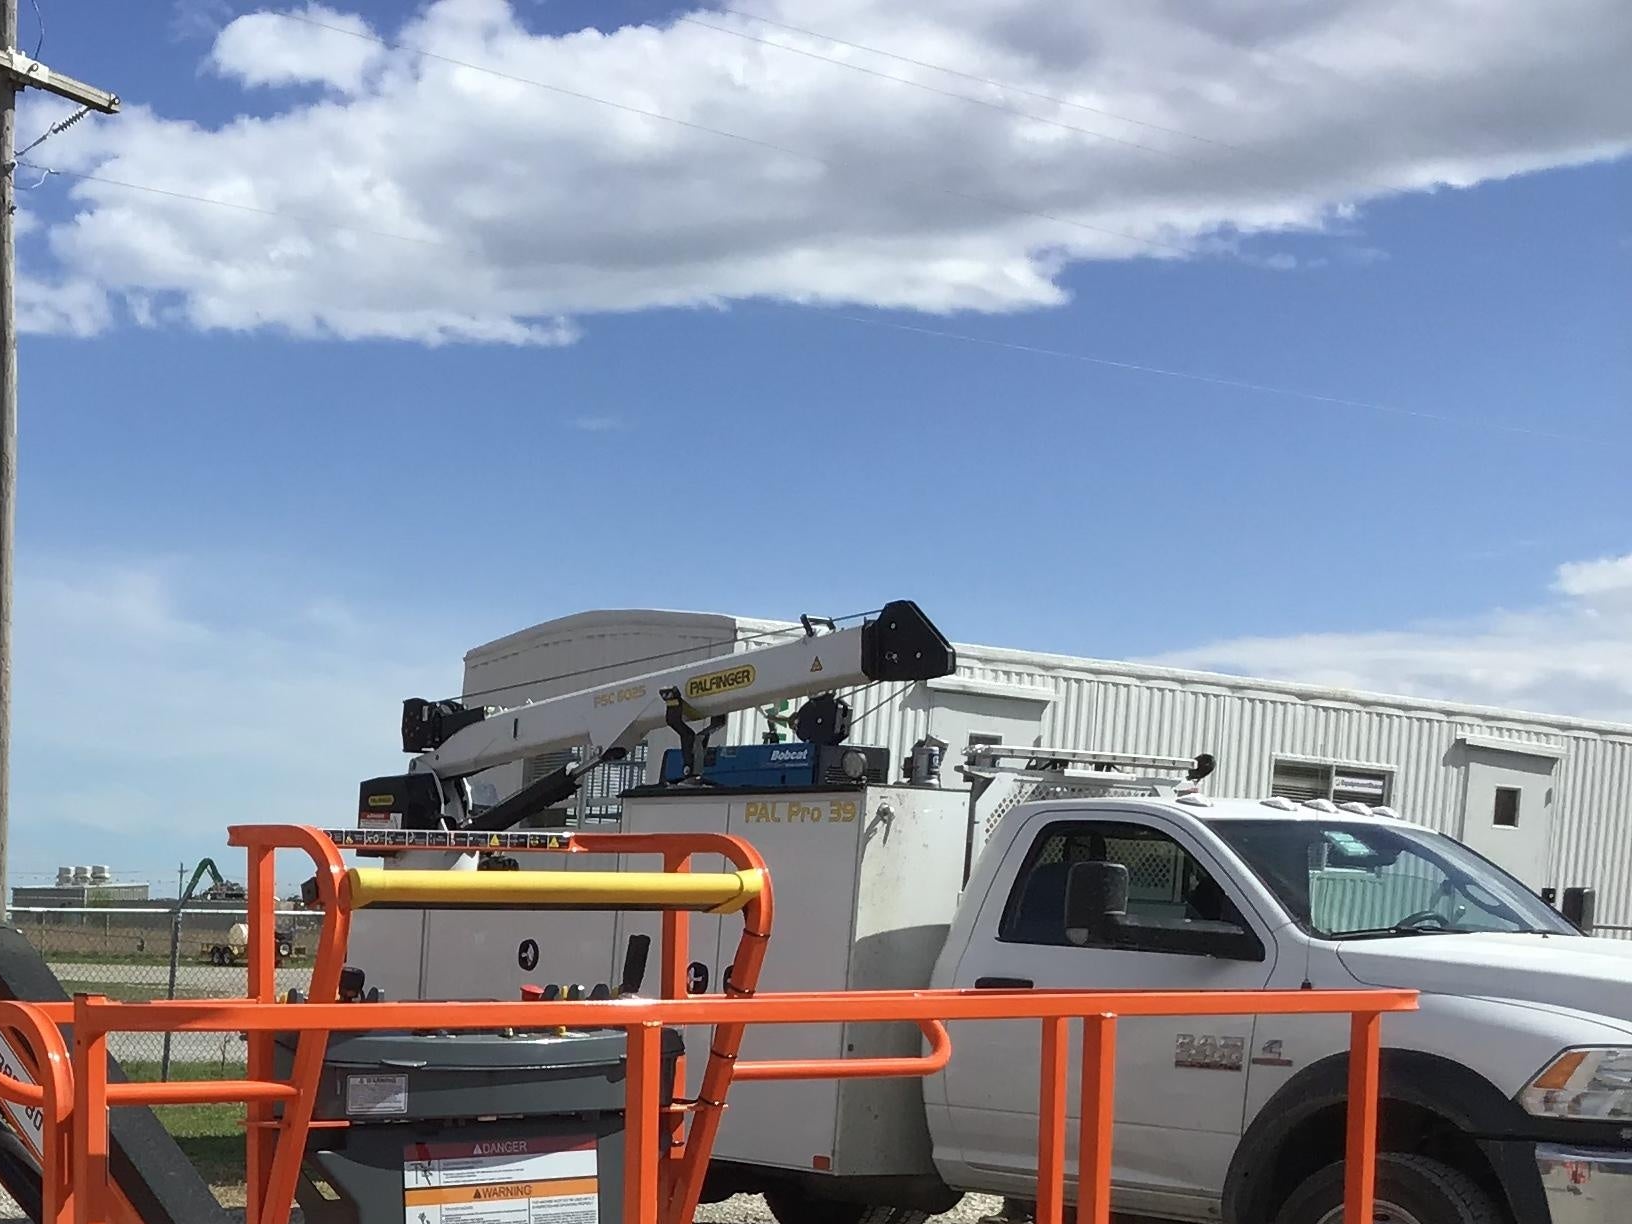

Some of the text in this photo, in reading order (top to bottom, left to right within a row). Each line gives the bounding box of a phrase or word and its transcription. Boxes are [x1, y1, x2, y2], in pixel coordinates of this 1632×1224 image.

[689, 668, 752, 696] PALFINGER
[771, 749, 808, 760] Bobcat
[745, 801, 857, 823] PAL Pro 39
[481, 1140, 528, 1155] DANGER
[482, 1184, 533, 1199] WARNING
